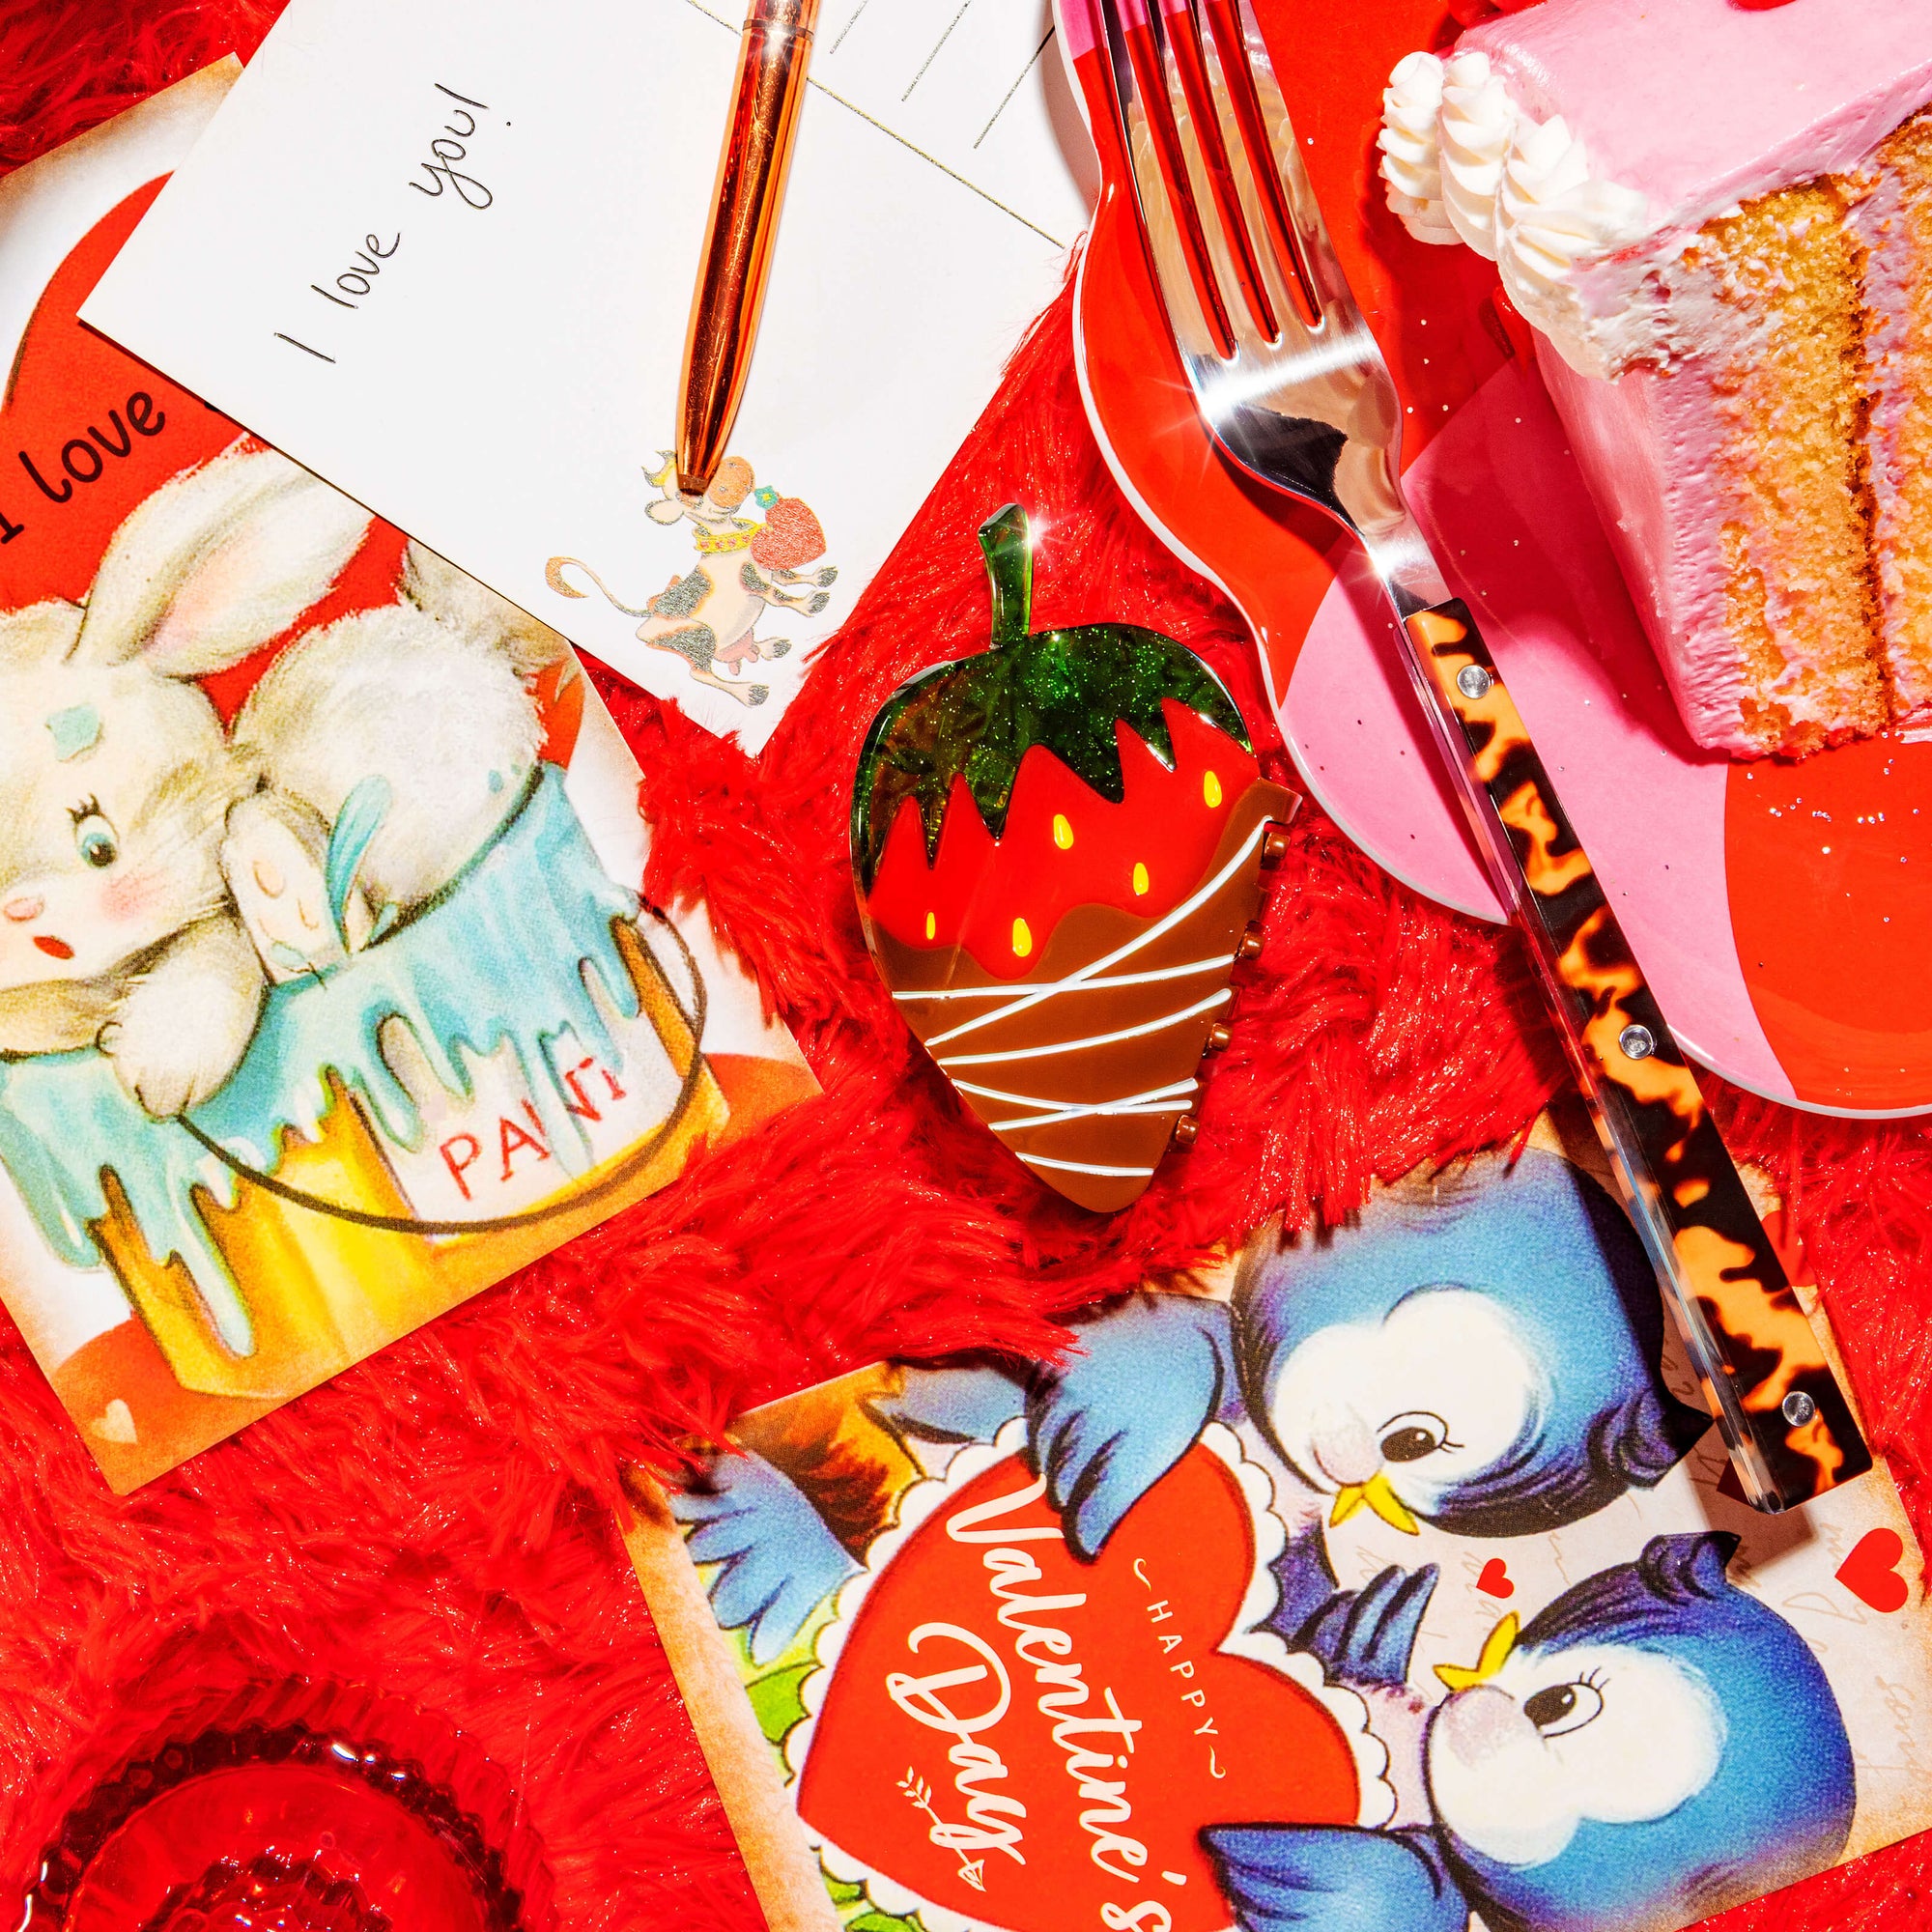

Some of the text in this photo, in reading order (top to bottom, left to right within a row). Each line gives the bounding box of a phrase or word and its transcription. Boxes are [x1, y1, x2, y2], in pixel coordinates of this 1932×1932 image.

[273, 83, 512, 364] I love you!
[17, 391, 165, 503] love
[886, 1622, 1027, 1866] Day
[1147, 1600, 1218, 1736] HAPPY
